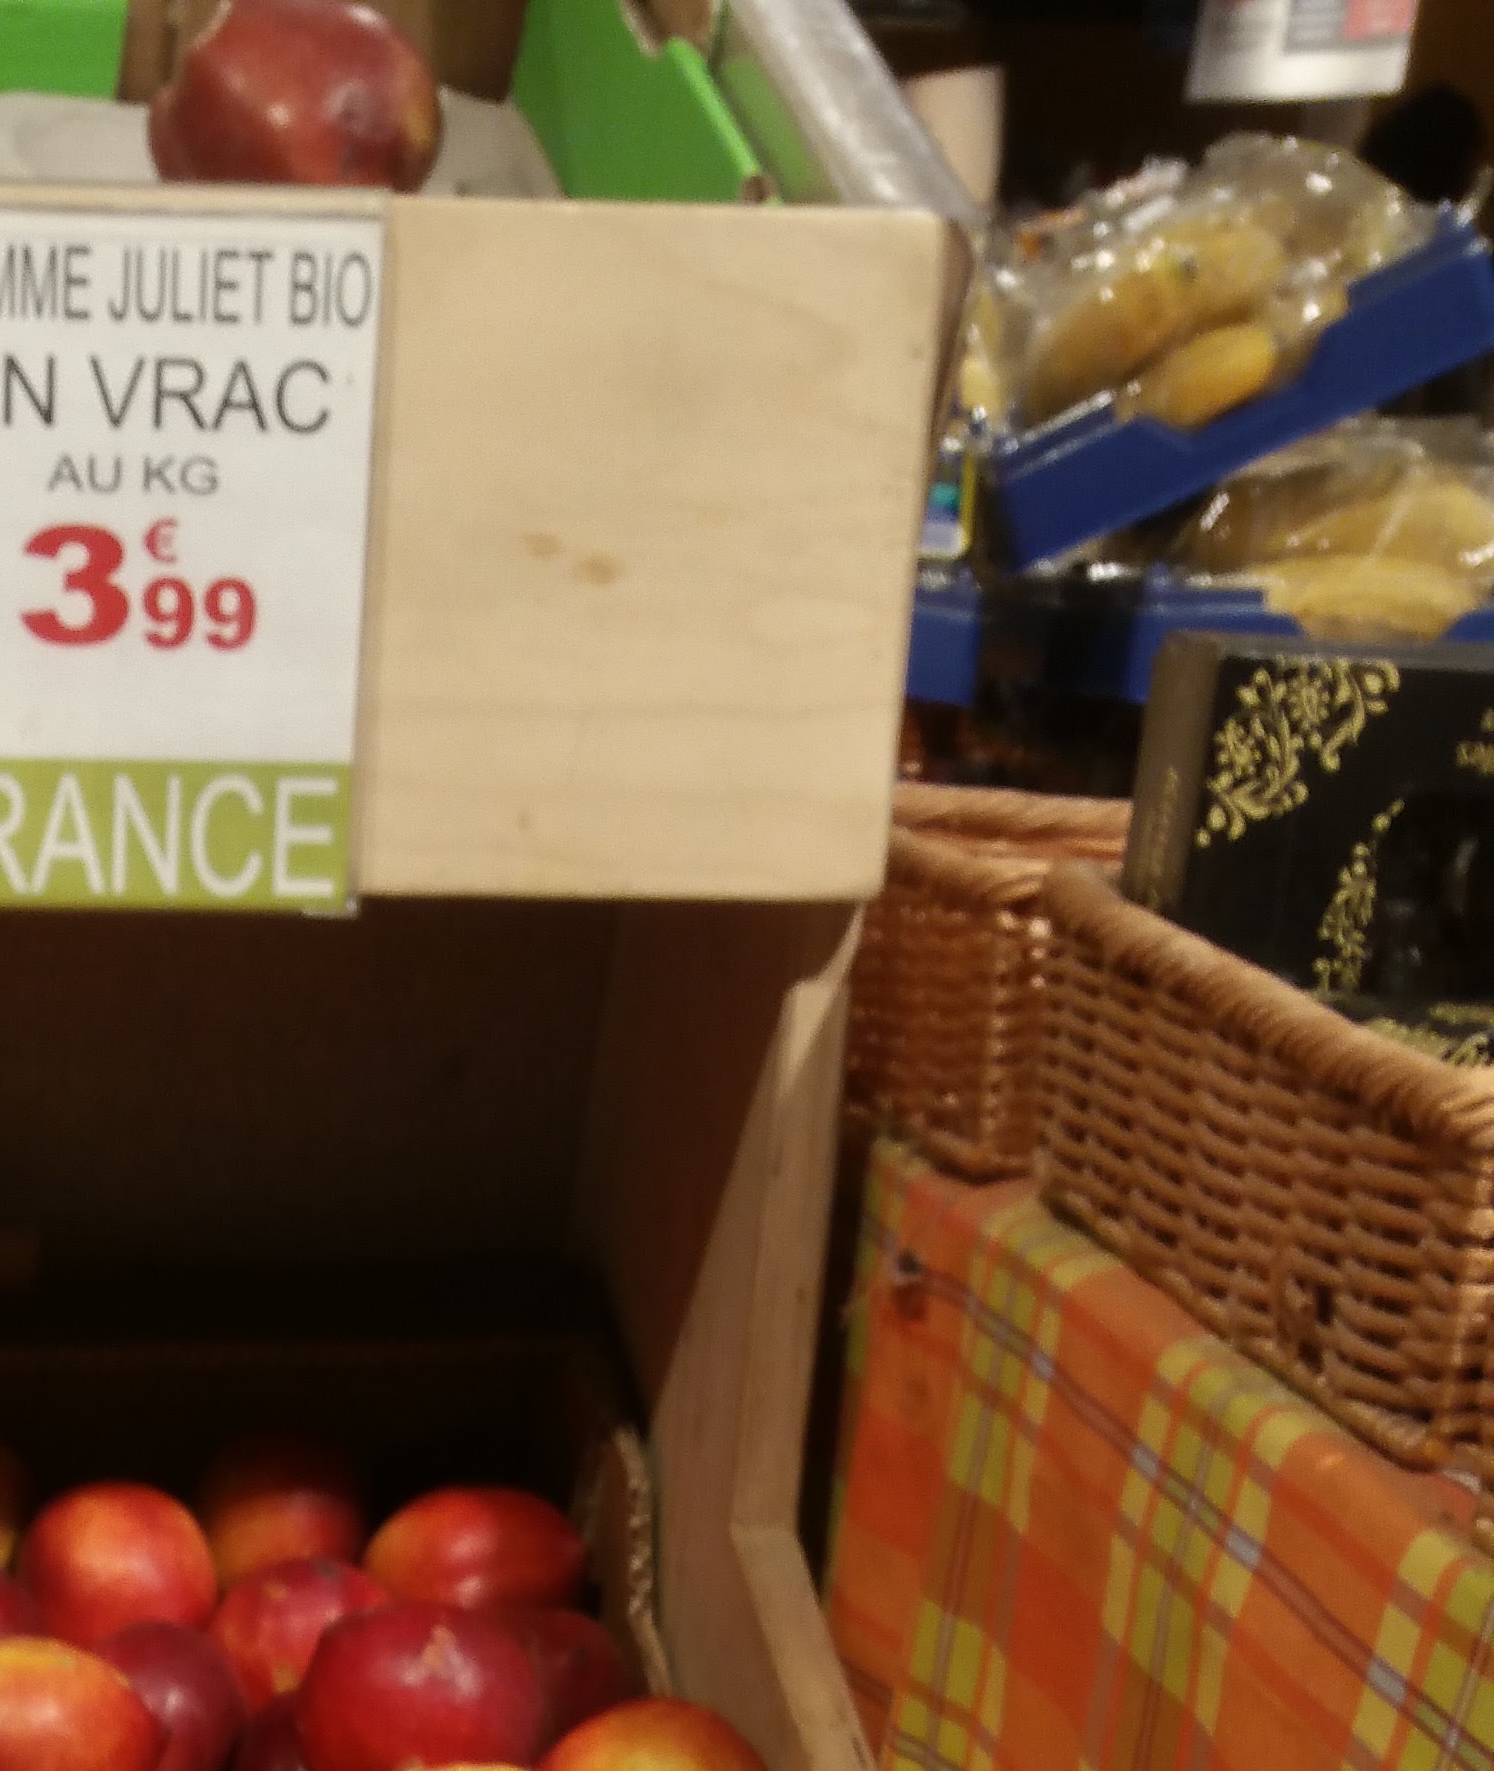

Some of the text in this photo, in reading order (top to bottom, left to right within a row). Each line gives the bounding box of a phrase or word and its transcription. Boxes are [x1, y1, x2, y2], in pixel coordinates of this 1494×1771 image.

[108, 246, 273, 324] JULIET
[289, 250, 372, 328] BIO
[90, 355, 329, 434] VRAC
[47, 452, 219, 496] AU KG
